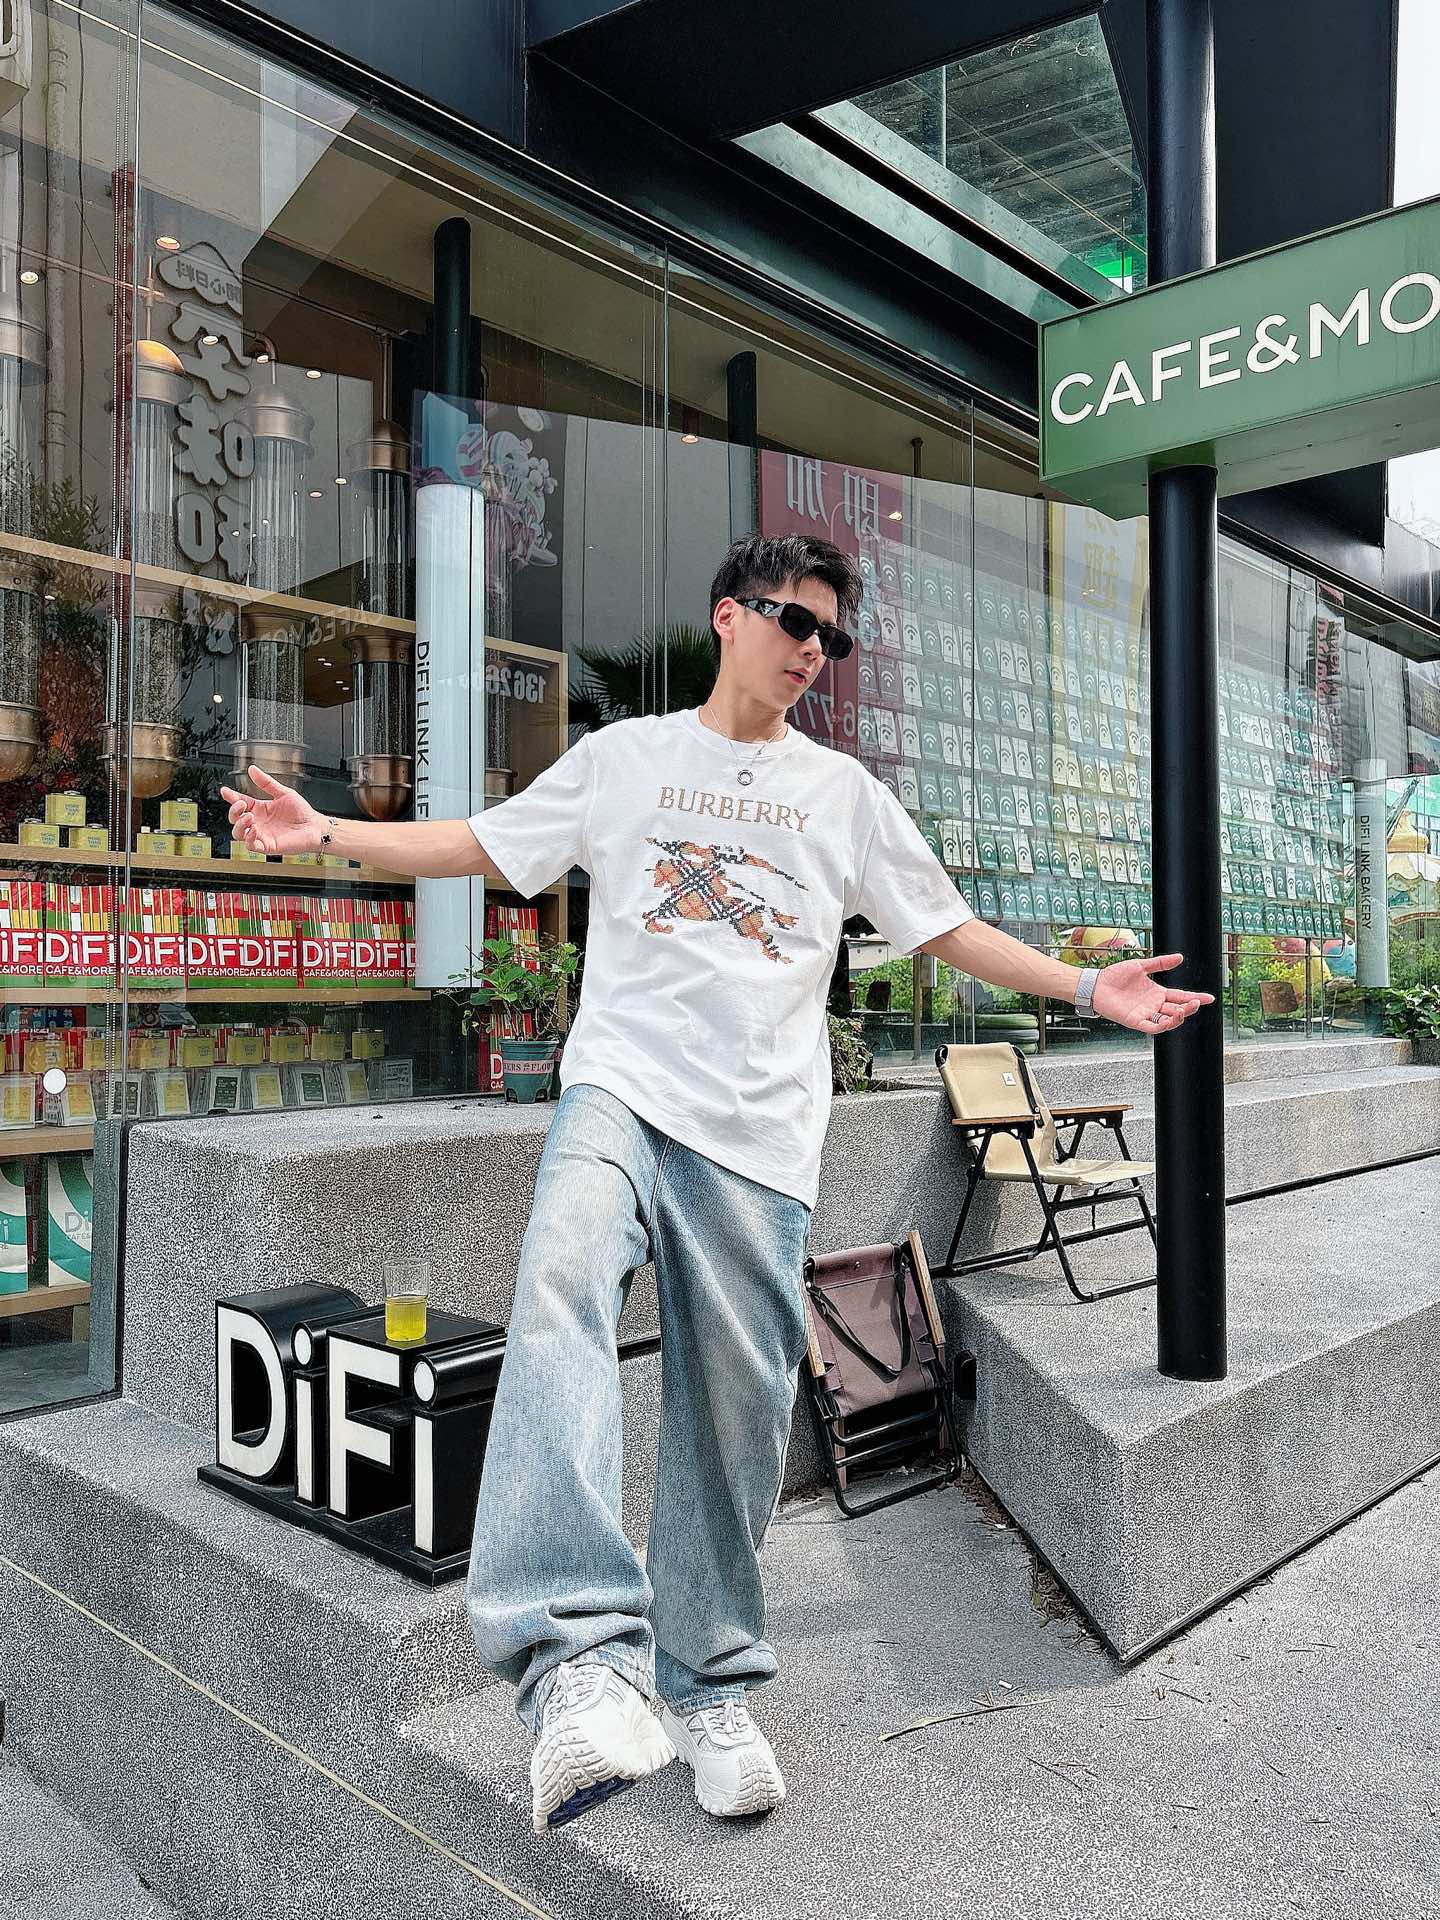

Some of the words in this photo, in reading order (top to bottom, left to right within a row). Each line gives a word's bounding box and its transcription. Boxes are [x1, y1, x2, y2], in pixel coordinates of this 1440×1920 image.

[1050, 272, 1440, 425] CAFE&MO
[417, 641, 430, 692] DiFi
[417, 702, 430, 766] LINK
[417, 778, 429, 821] LIF
[657, 785, 810, 833] BURBERRY
[1360, 844, 1370, 872] LINK
[1361, 876, 1372, 930] BAKERY
[45, 932, 115, 964] DiFi
[119, 934, 184, 965] DiFi
[244, 939, 297, 966] DiFi
[303, 941, 354, 968] DiFi
[355, 942, 405, 968] DiFi
[45, 965, 117, 975] CAFE&MORE
[188, 967, 245, 976] CAFE&MORE
[244, 968, 297, 977] CAFE&MORE
[303, 969, 354, 978] CAFE&MORE
[356, 969, 405, 978] CAFE&MORE
[216, 1306, 435, 1554] DiFi
